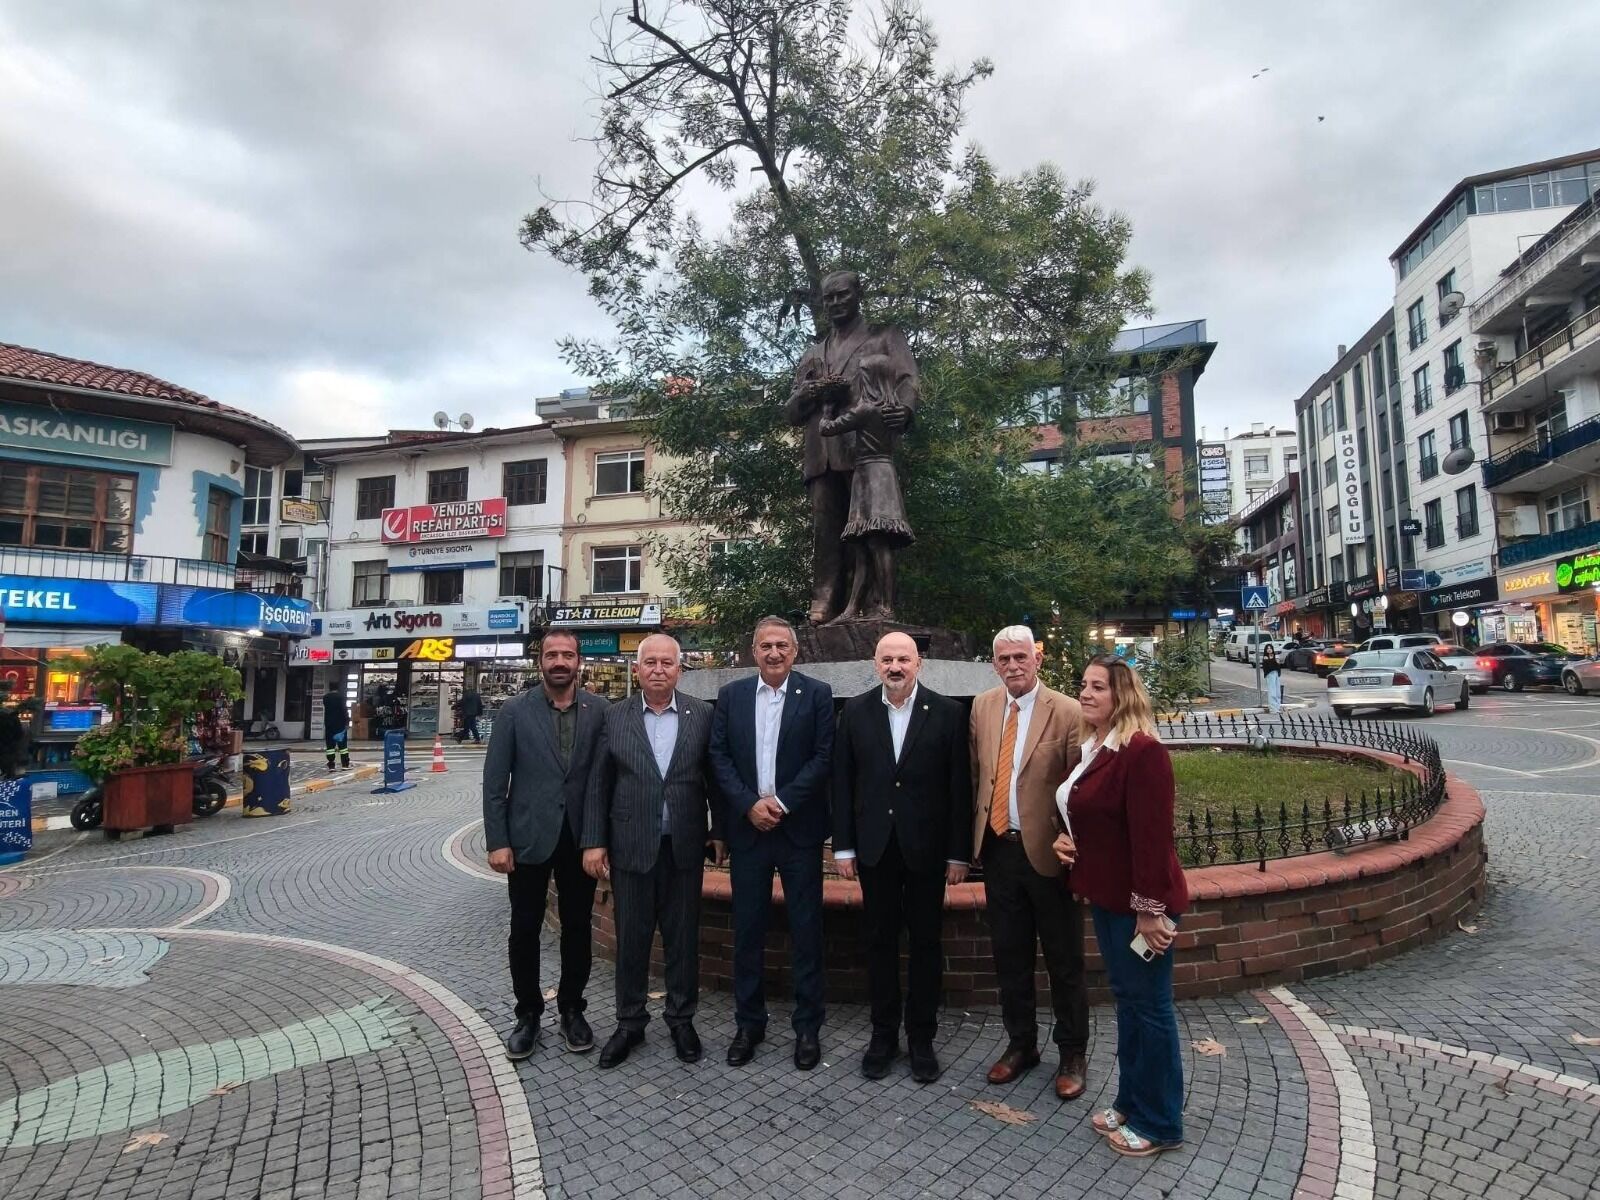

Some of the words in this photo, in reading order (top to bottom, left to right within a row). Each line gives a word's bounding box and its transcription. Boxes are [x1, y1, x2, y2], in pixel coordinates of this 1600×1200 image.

[413, 518, 451, 533] REFAH
[0, 588, 77, 610] TEKEL
[1454, 589, 1481, 601] Telekom
[260, 601, 306, 625] İŞGÖREN
[393, 611, 443, 633] Sigorta
[593, 607, 641, 619] TELEKOM
[376, 649, 389, 658] CAT
[400, 638, 454, 661] ARS
